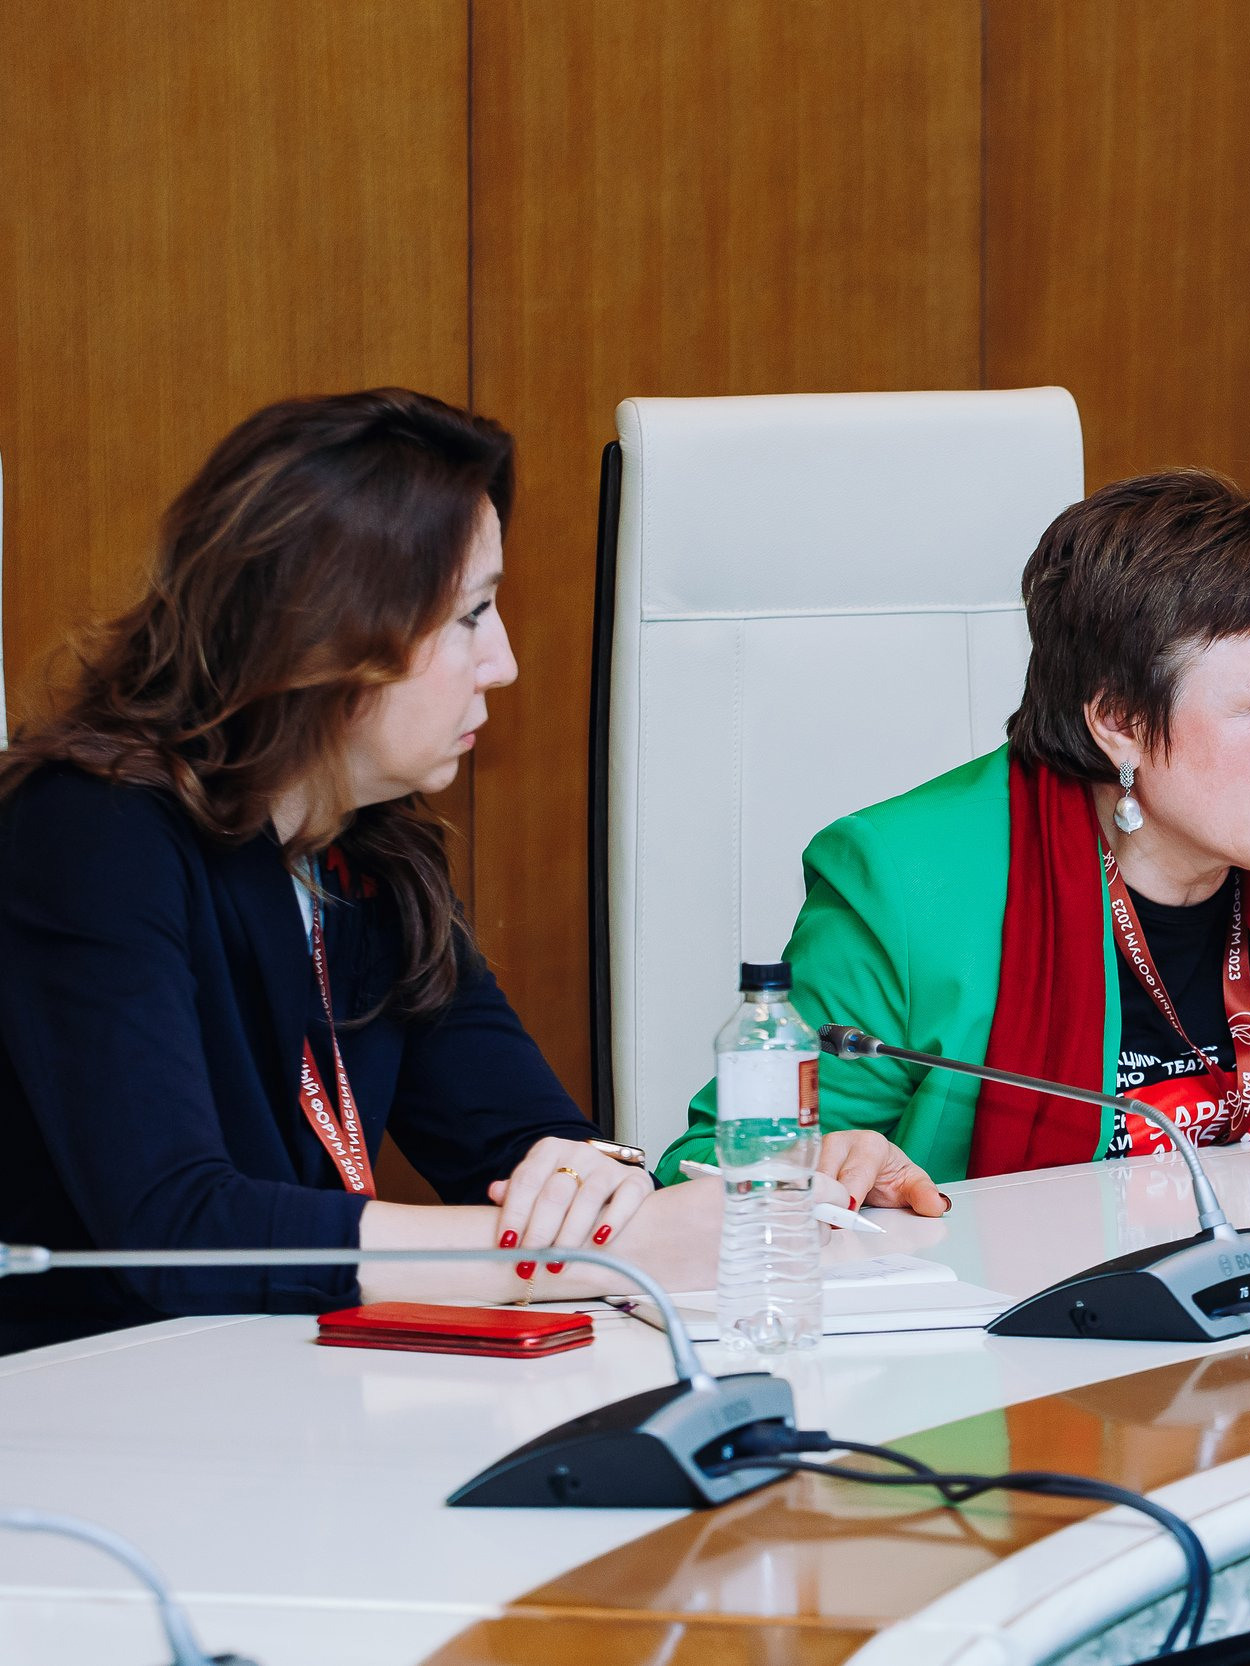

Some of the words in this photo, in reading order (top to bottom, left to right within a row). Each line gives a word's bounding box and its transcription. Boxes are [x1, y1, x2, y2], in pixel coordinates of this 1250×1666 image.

[1111, 898, 1133, 932] 2023
[1231, 888, 1242, 945] ФОРУМ
[1125, 932, 1156, 986] ФОРУМ
[1228, 947, 1242, 981] 2023
[1118, 1051, 1161, 1070] ЦИИ
[311, 1098, 347, 1156] ФОРУМ
[341, 1157, 365, 1191] 2023
